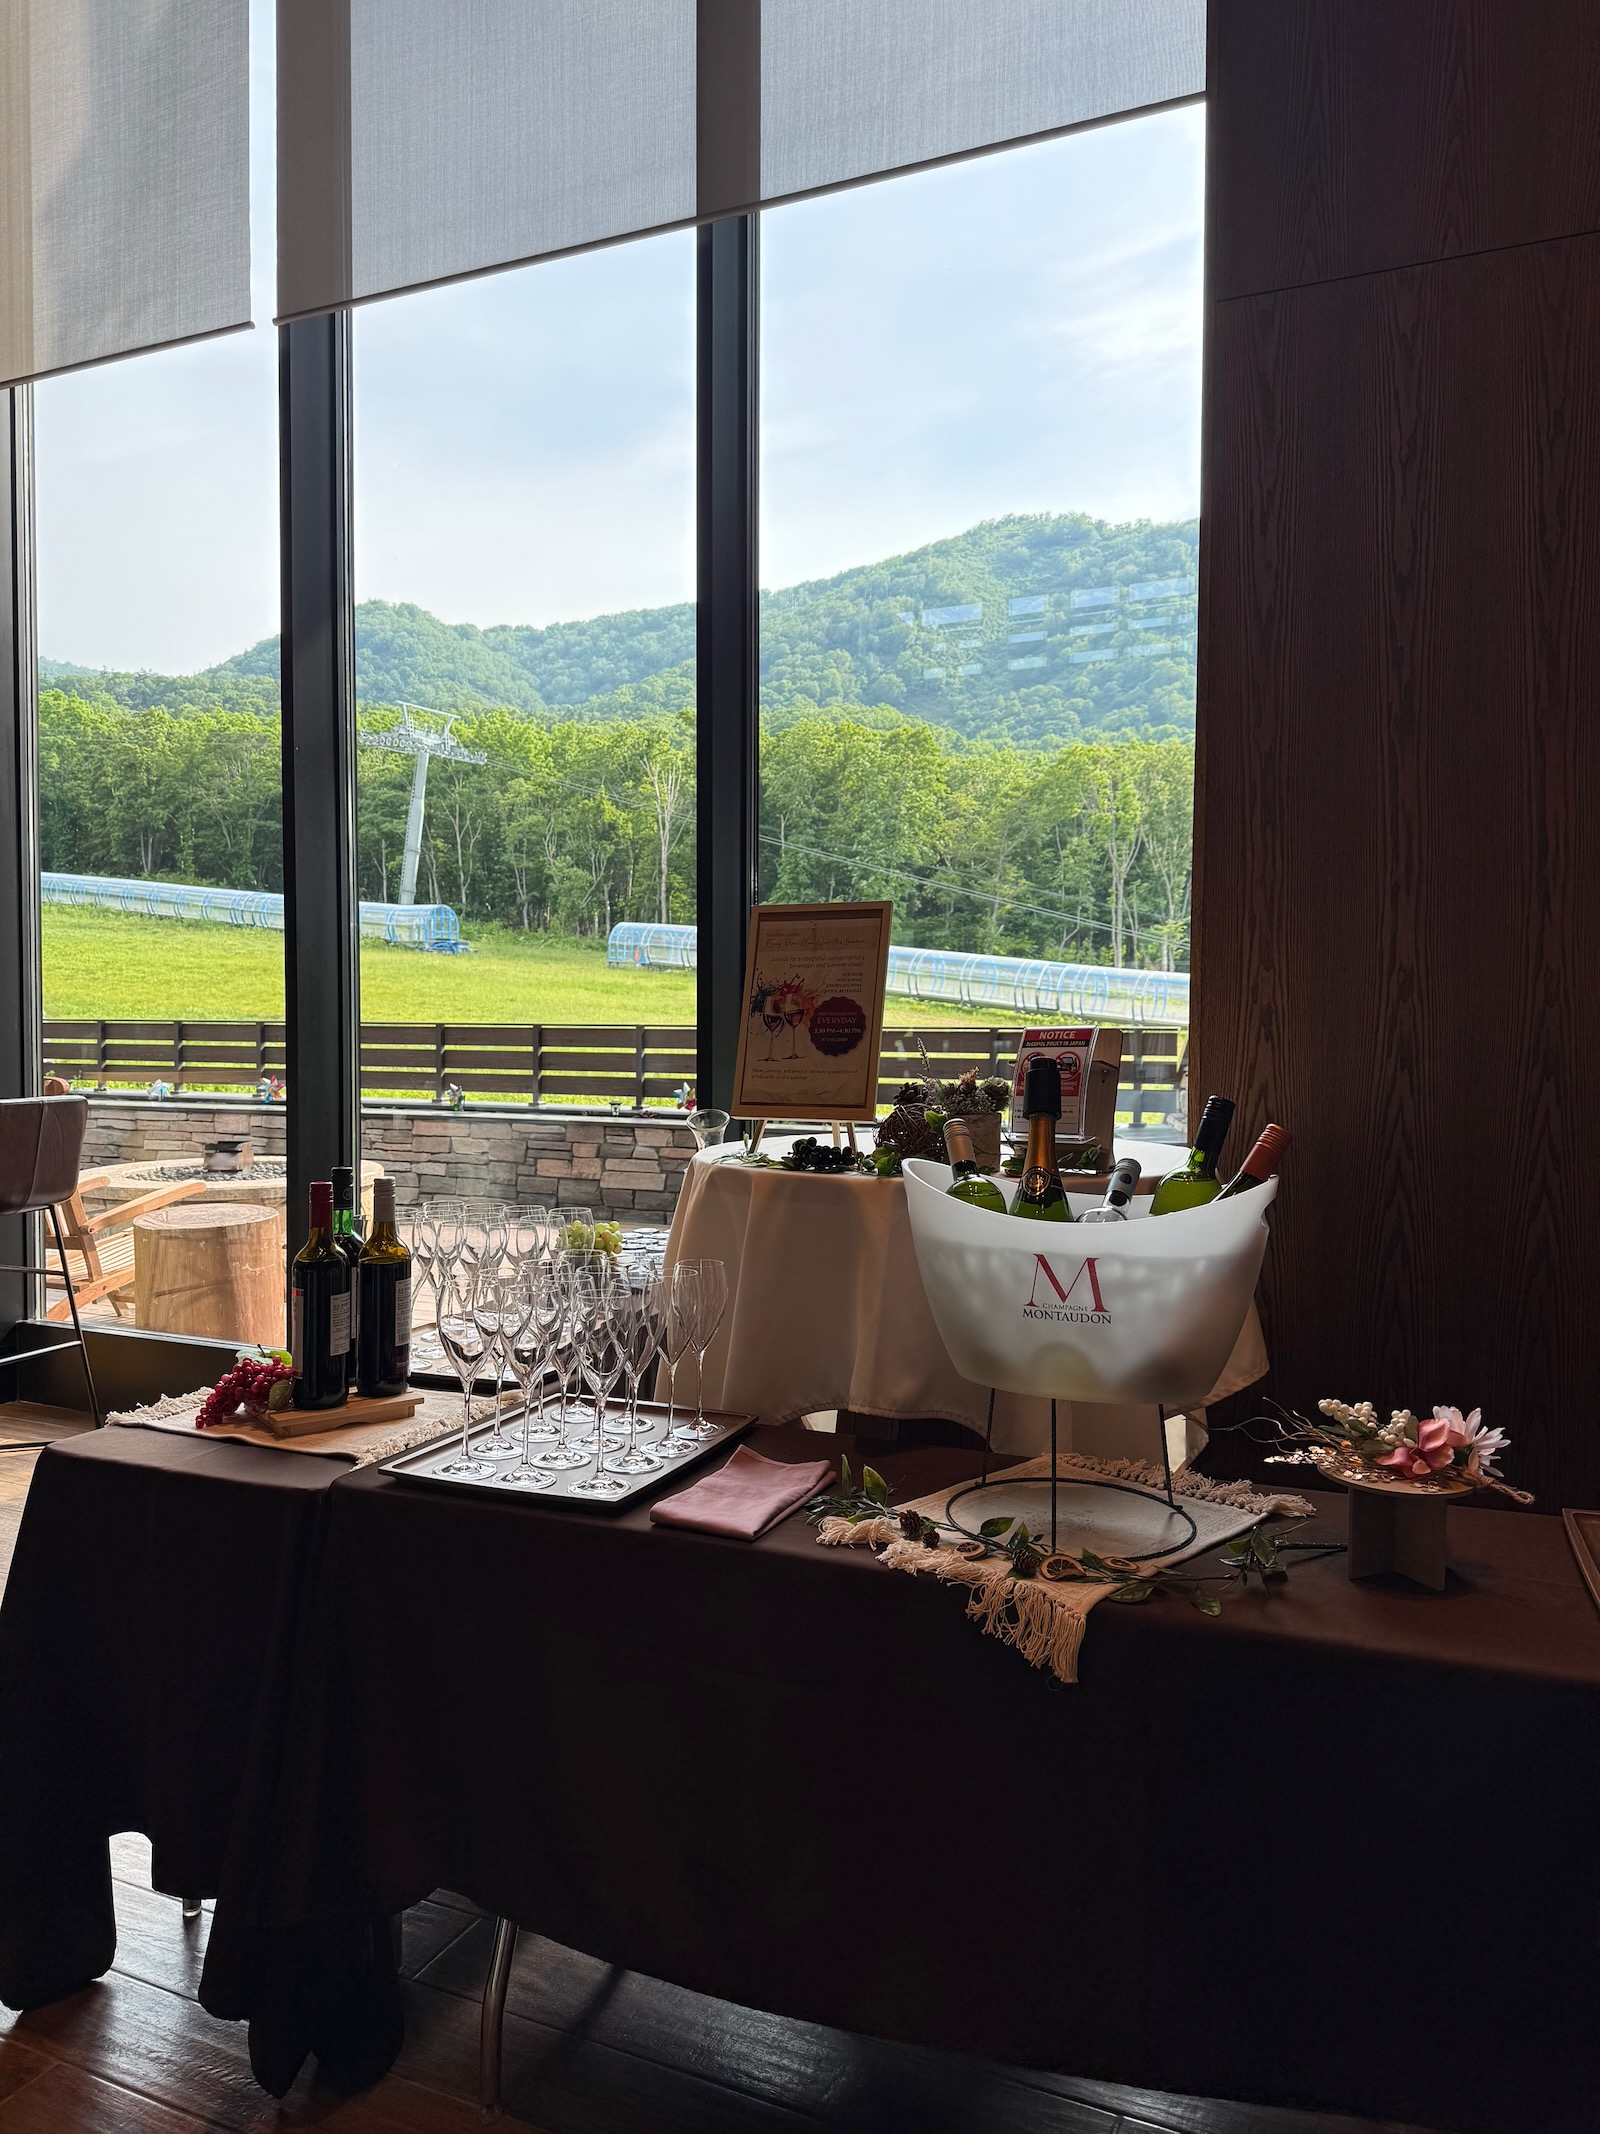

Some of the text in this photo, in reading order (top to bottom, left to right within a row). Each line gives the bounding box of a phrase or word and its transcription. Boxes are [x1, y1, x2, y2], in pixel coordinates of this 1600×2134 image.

[817, 1016, 857, 1025] EVERYDAY
[1039, 1030, 1077, 1040] NOTICE
[1023, 1253, 1111, 1313] M
[1042, 1302, 1088, 1311] CHAMPAGNE
[1022, 1308, 1112, 1324] MONTAUDON
